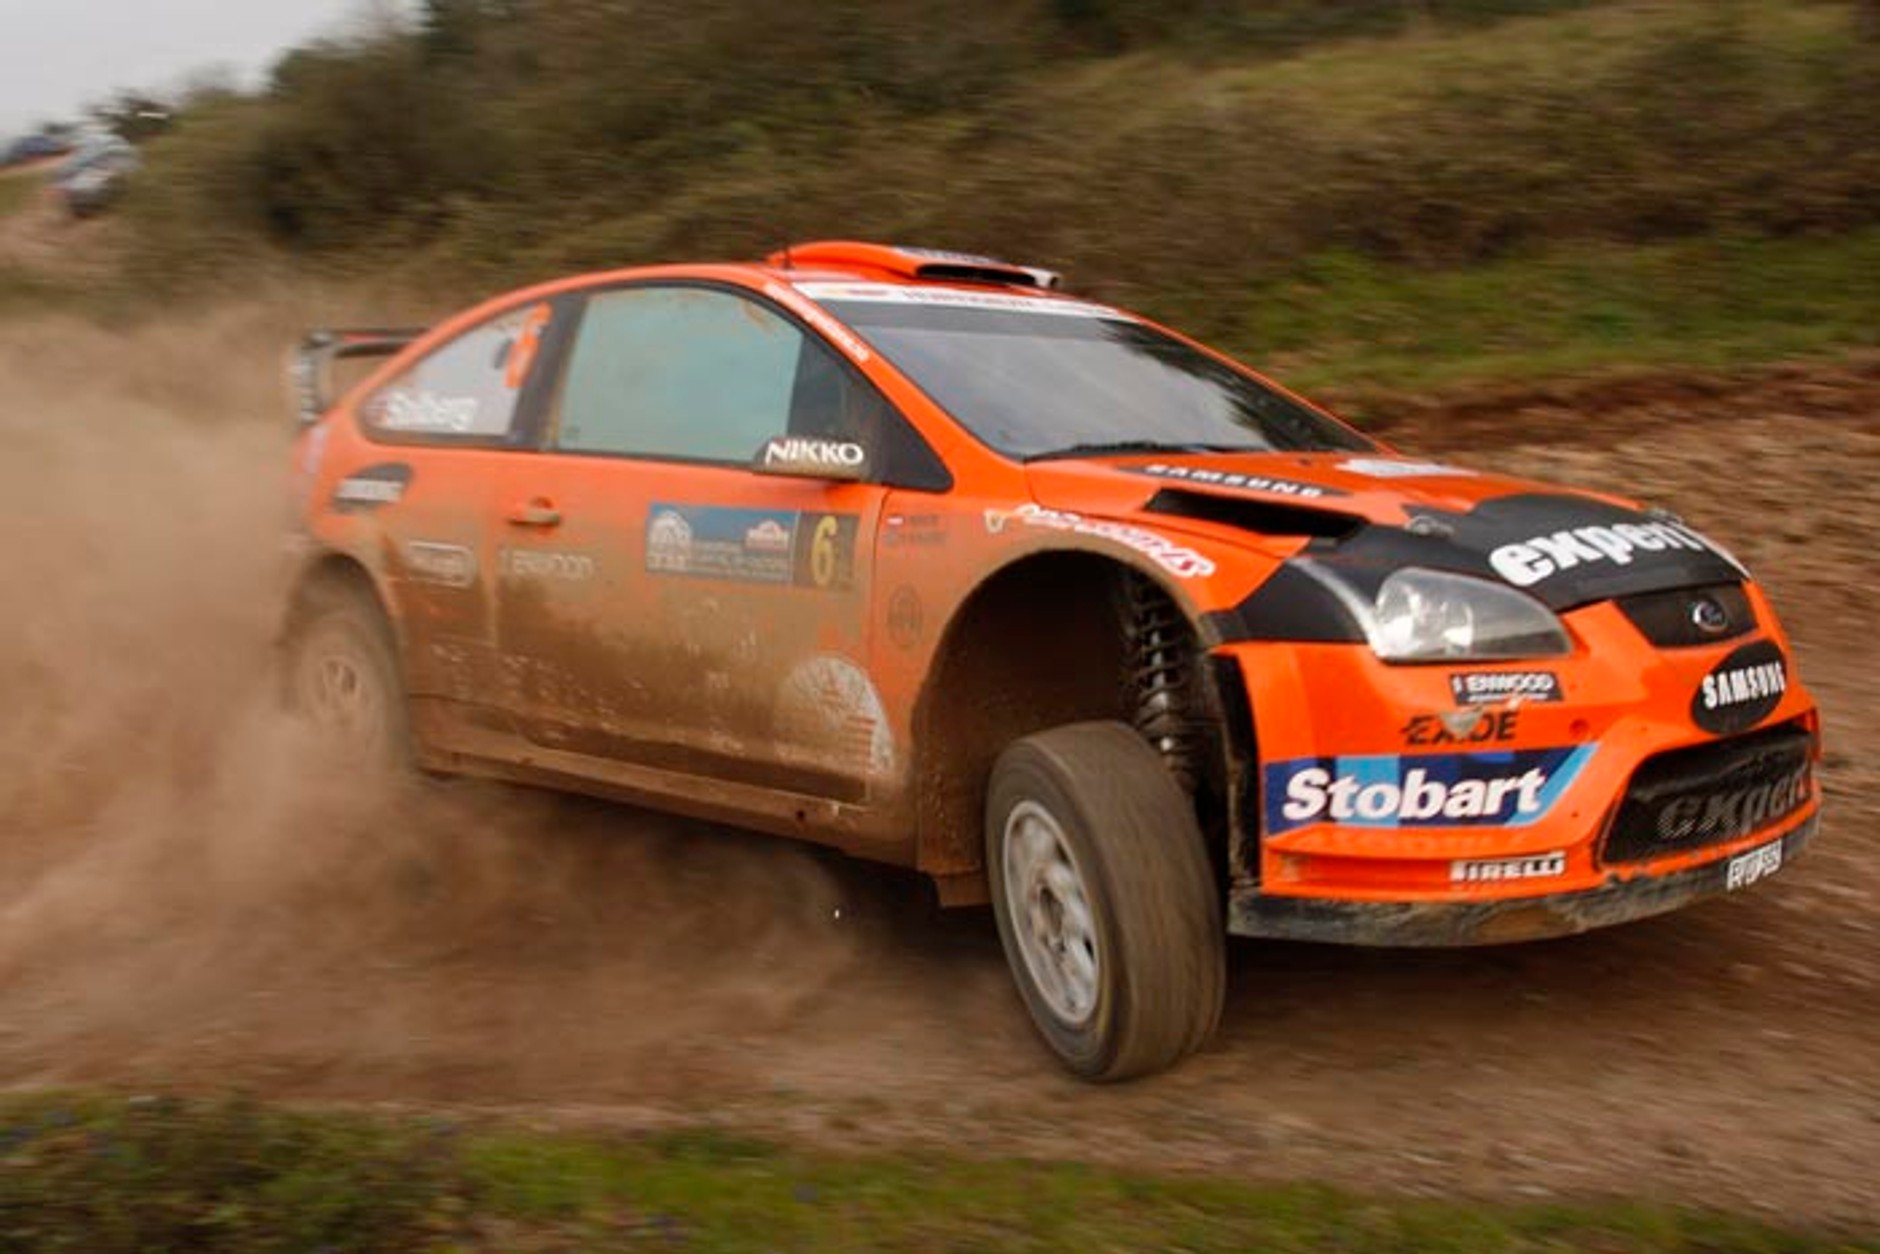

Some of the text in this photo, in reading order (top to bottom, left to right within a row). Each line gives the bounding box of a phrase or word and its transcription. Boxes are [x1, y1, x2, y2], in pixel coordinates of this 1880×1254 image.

[764, 438, 864, 466] NIKKO
[1145, 464, 1323, 498] SAMSUNG
[810, 515, 838, 585] 6
[1702, 660, 1786, 709] SAMSUNG
[1282, 767, 1548, 820] Stobart
[1450, 850, 1566, 881] PIRELLI
